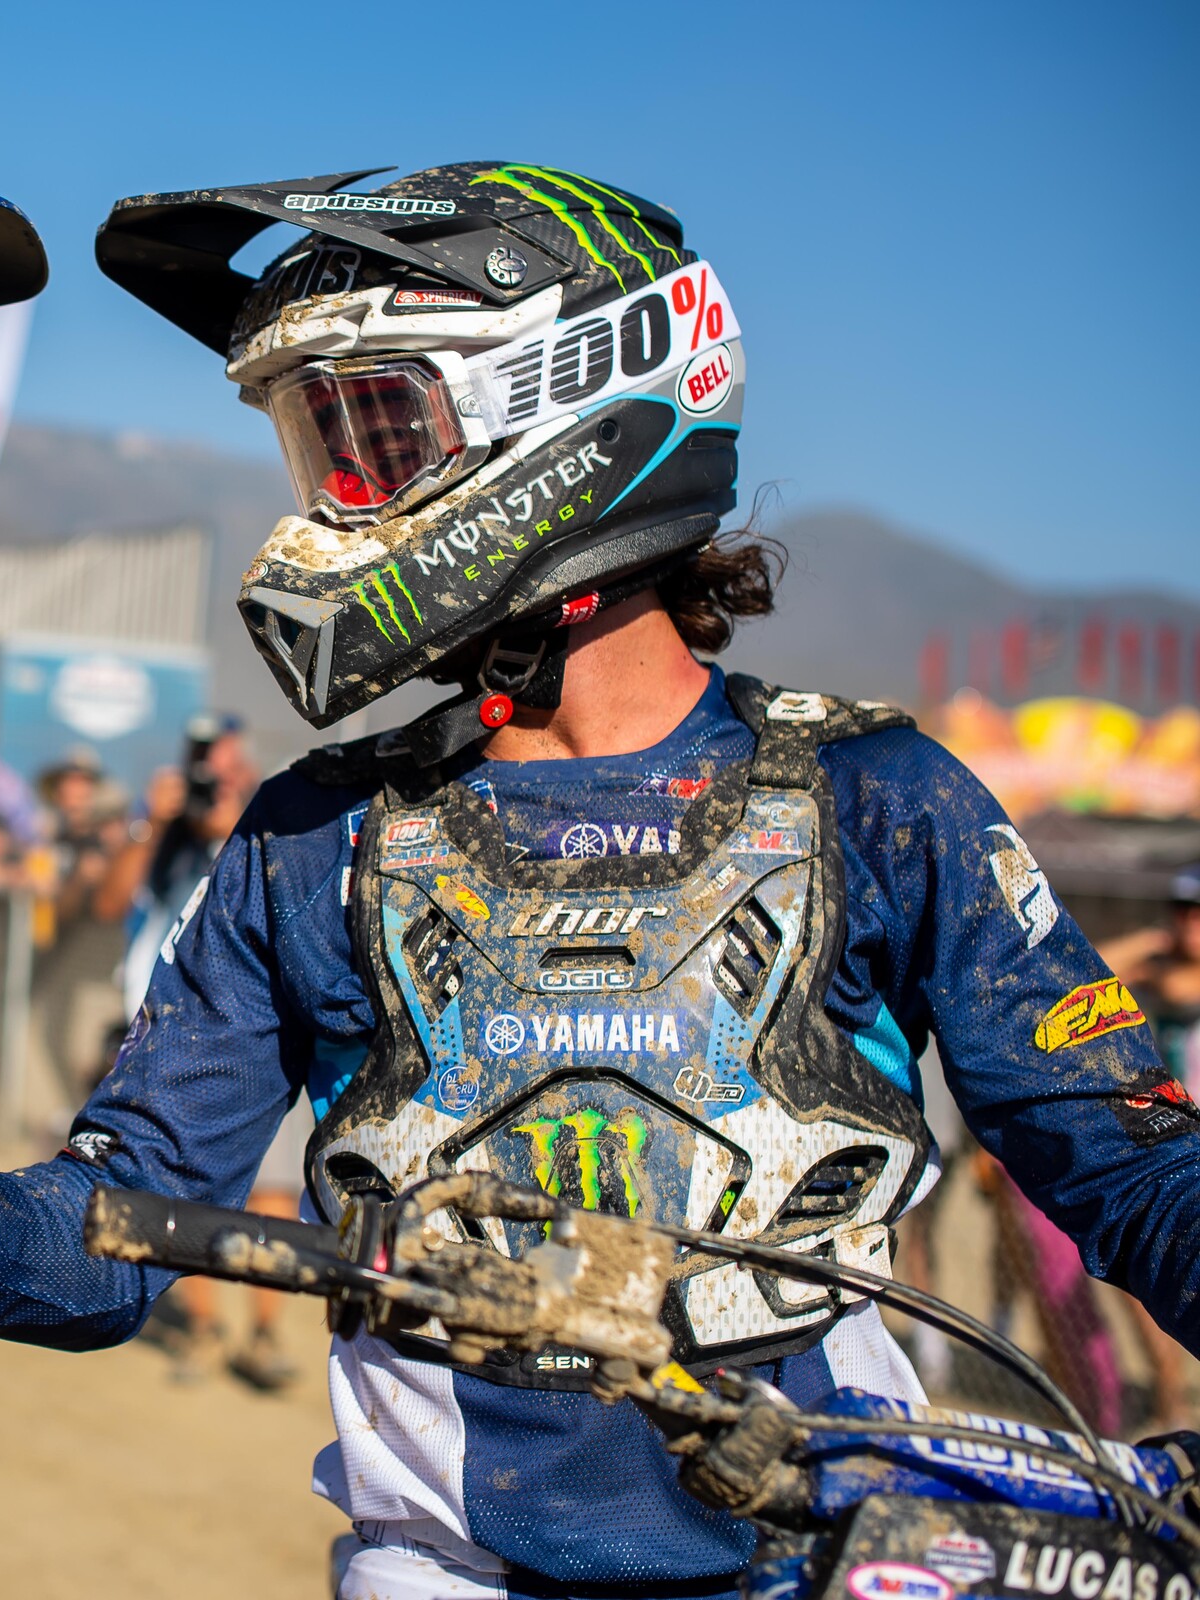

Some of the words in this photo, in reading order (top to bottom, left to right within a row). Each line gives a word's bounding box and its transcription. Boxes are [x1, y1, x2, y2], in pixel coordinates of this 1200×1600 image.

[284, 193, 457, 215] apdesigns
[421, 291, 478, 304] SPHERICAL
[496, 268, 723, 425] 100%
[687, 354, 730, 405] BELL
[411, 440, 613, 577] MONSTER
[463, 489, 594, 582] ENERGY
[531, 1013, 681, 1053] YAMAHA
